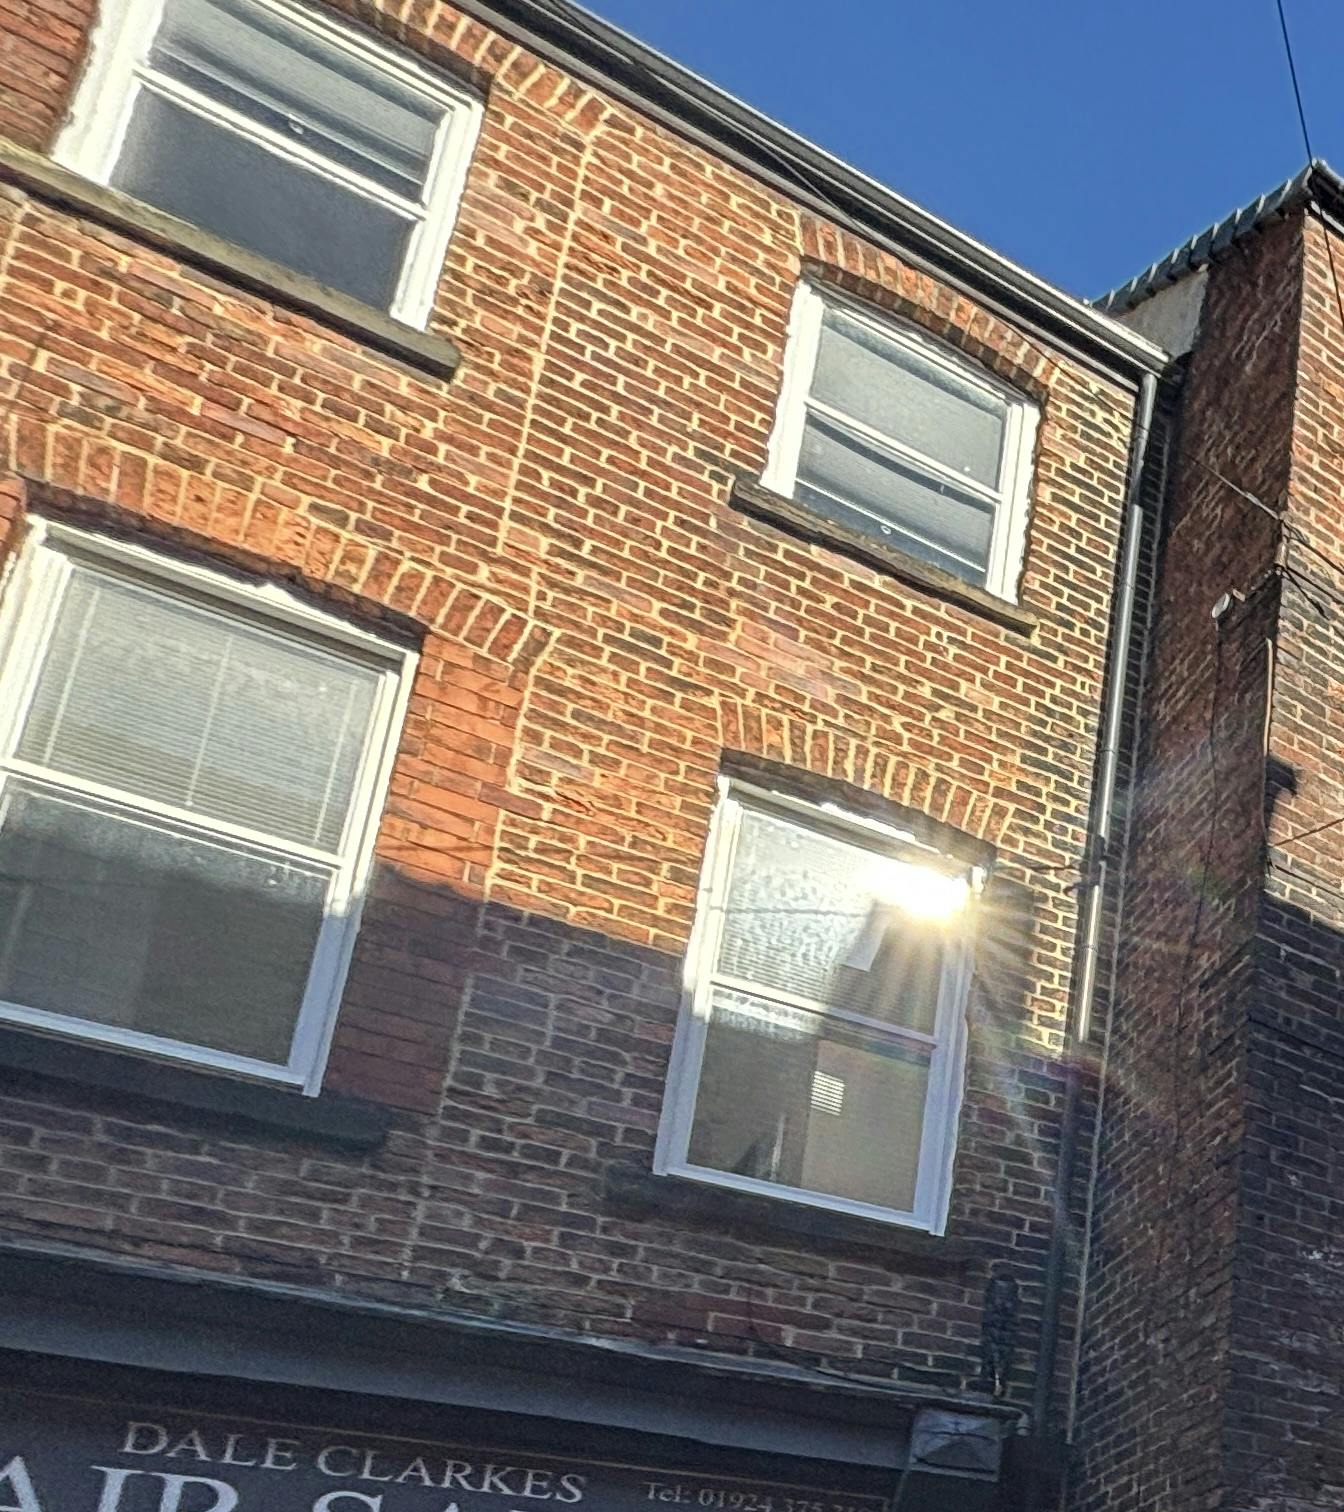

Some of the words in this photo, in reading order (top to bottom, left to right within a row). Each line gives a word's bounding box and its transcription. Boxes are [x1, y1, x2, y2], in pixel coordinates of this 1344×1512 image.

[120, 1421, 299, 1470] DALE
[317, 1445, 587, 1503] CLARKES
[699, 1489, 773, 1512] 01924
